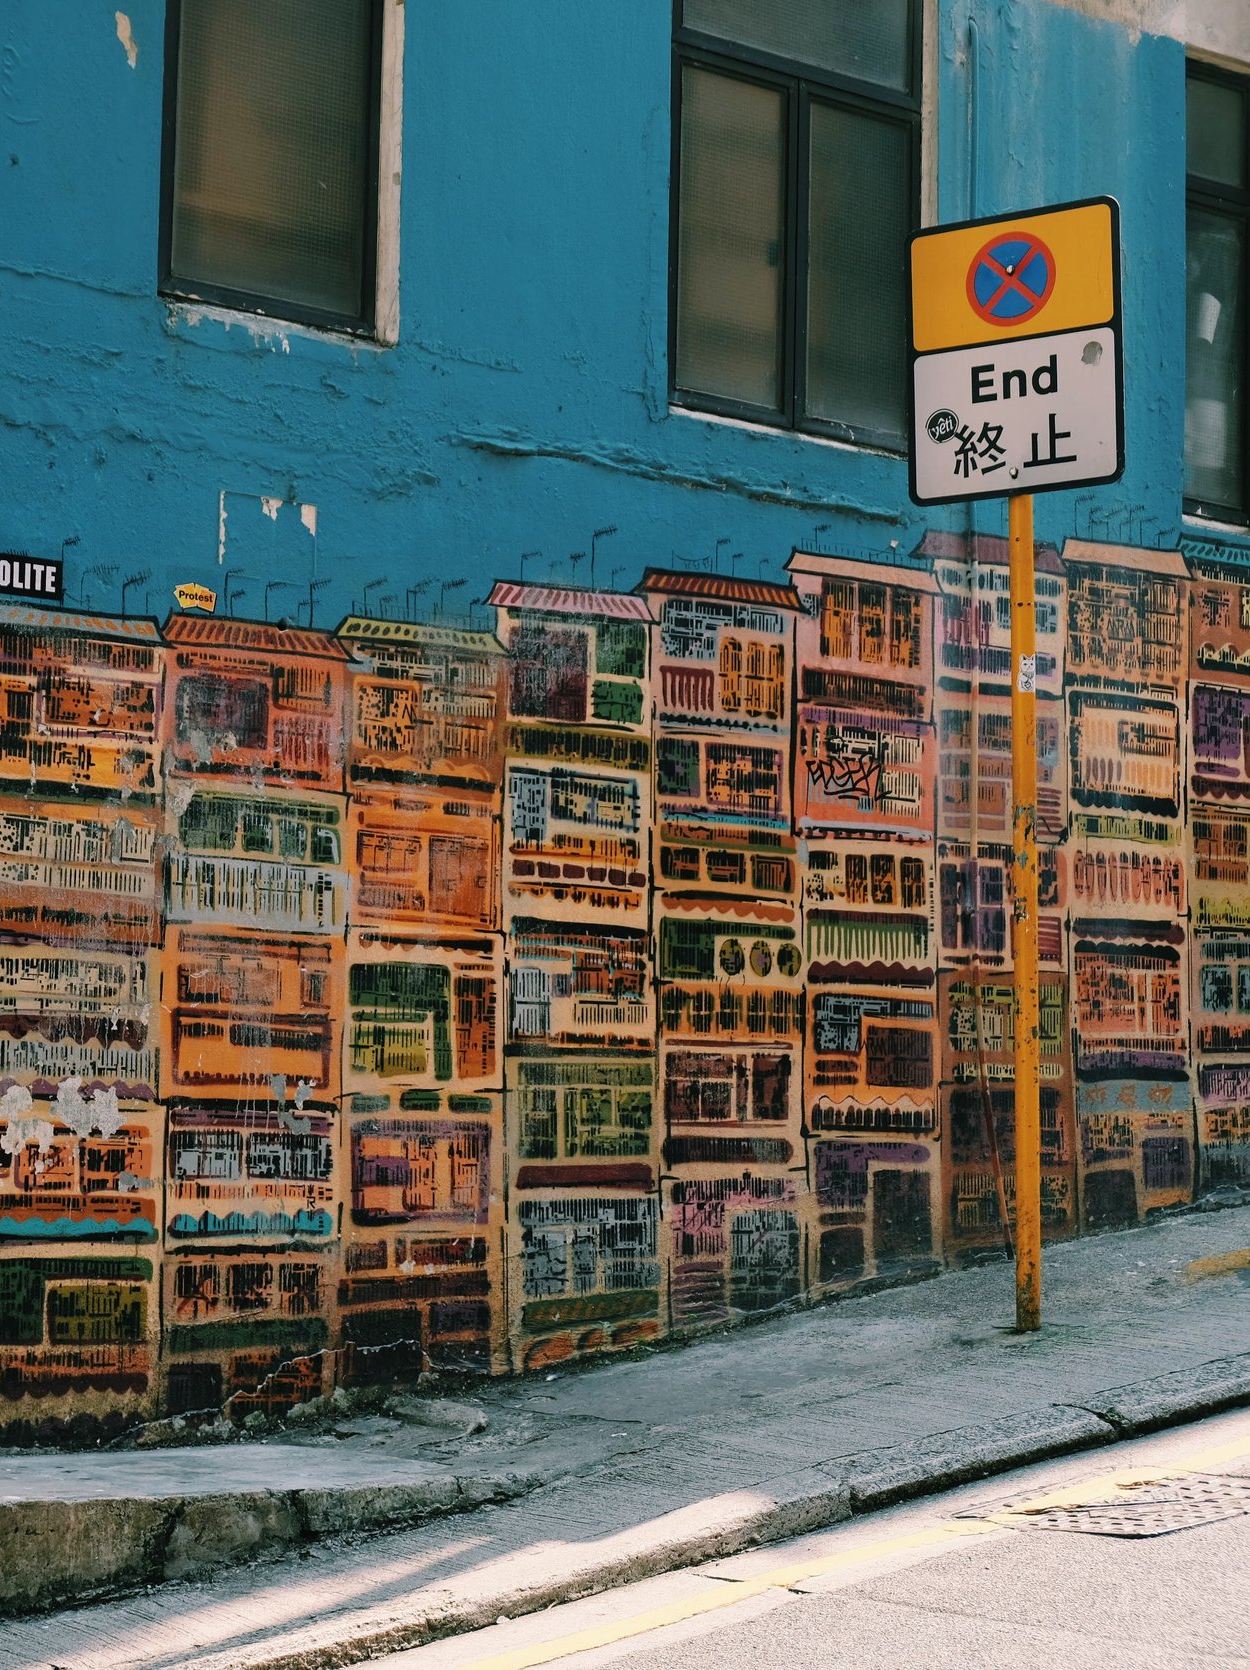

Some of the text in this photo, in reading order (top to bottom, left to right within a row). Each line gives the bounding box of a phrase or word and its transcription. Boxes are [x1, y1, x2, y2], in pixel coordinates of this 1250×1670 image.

[971, 354, 1058, 404] End
[930, 416, 954, 439] yêti
[953, 413, 1077, 478] 終止
[179, 590, 213, 602] Protest
